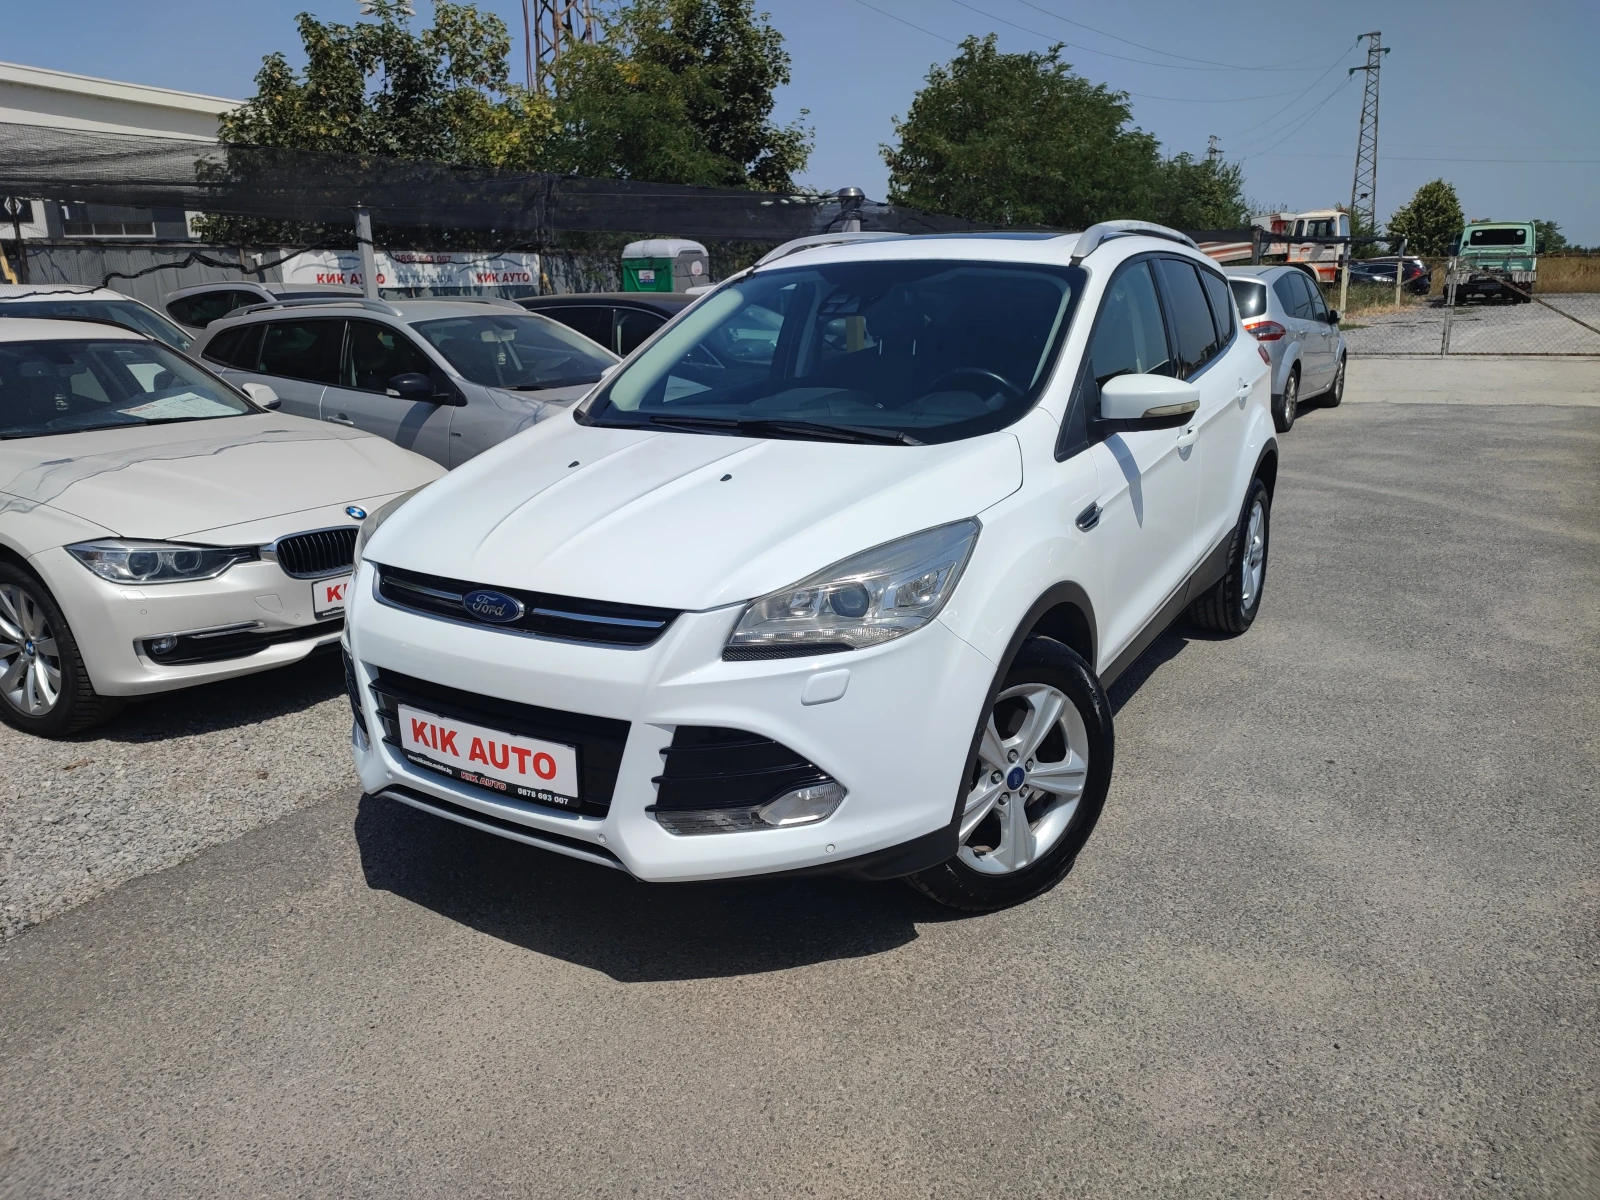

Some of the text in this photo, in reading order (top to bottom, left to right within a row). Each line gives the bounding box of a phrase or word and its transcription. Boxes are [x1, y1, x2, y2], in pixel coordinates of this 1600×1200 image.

[316, 273, 345, 284] КИК
[476, 272, 530, 283] КИК АУТО
[472, 594, 507, 617] Ford
[411, 717, 557, 780] KIK AUTO
[460, 771, 507, 791] KIK AUTO
[517, 787, 569, 805] 0878 693 007
